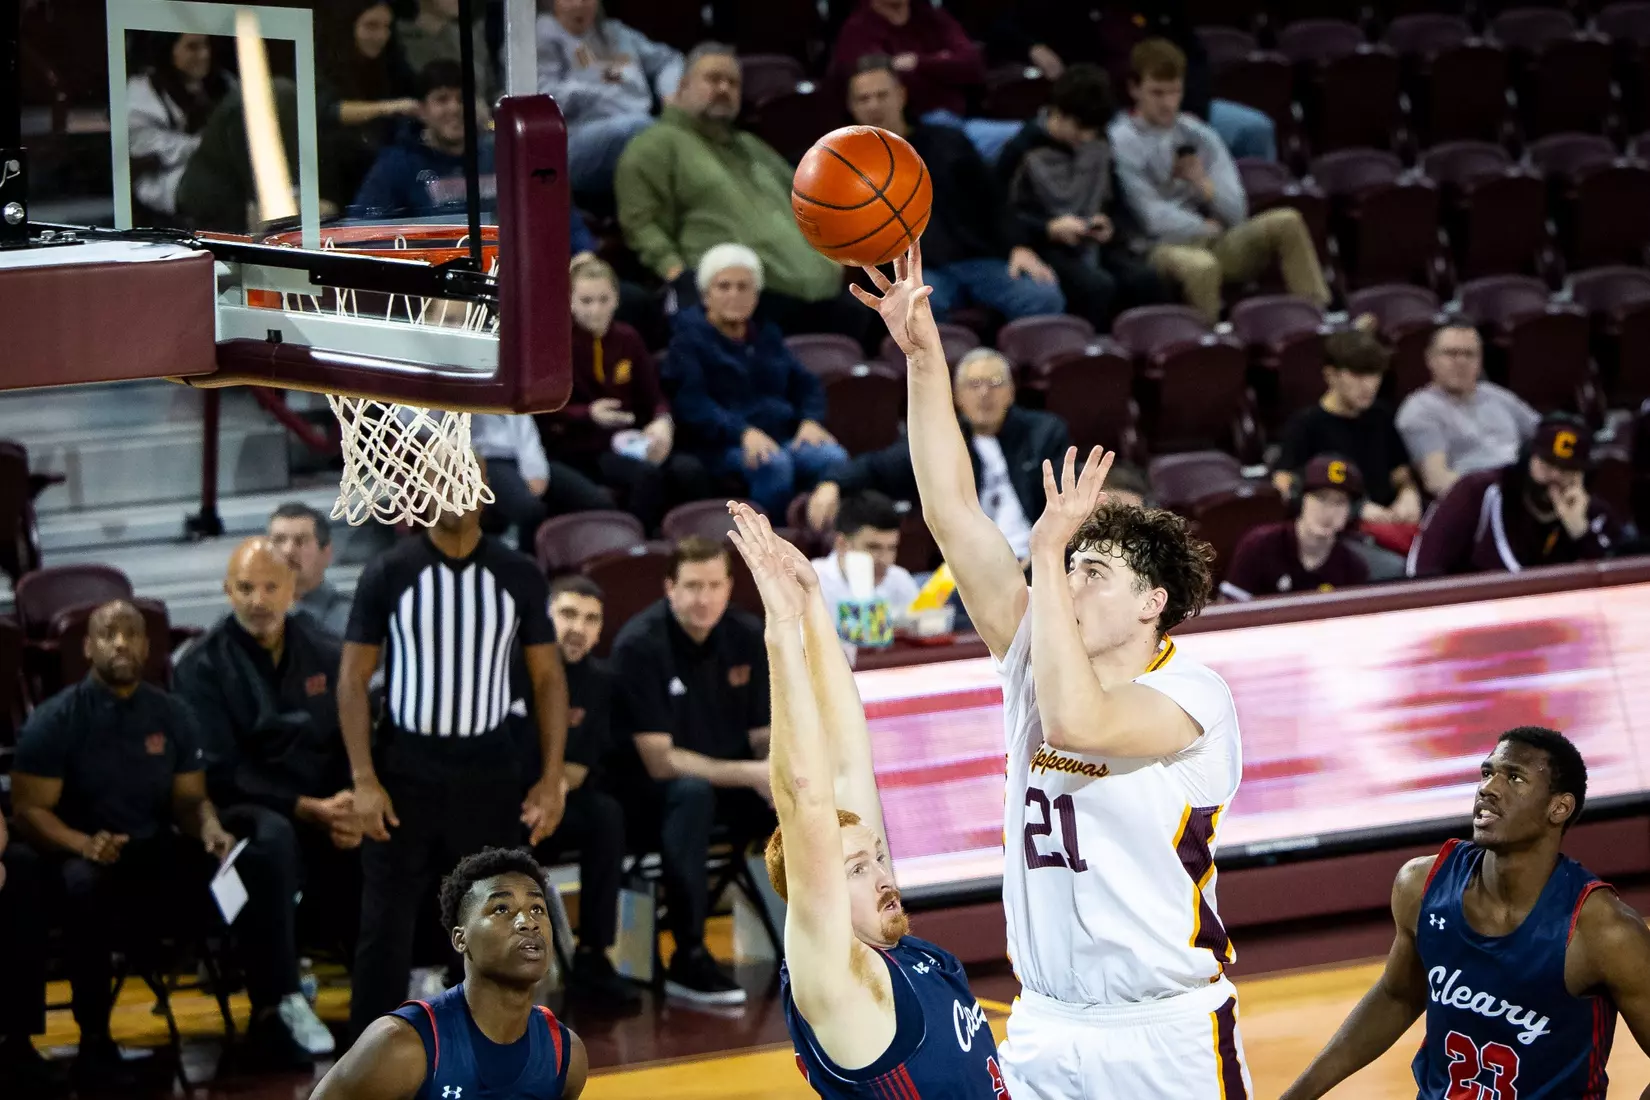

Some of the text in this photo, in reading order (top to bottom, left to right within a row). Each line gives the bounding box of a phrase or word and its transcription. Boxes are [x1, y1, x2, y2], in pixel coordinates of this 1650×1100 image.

[1328, 461, 1346, 484] C
[1553, 431, 1577, 459] C
[1024, 786, 1088, 873] 21
[1428, 965, 1551, 1045] Cleary
[1444, 1029, 1520, 1100] 23
